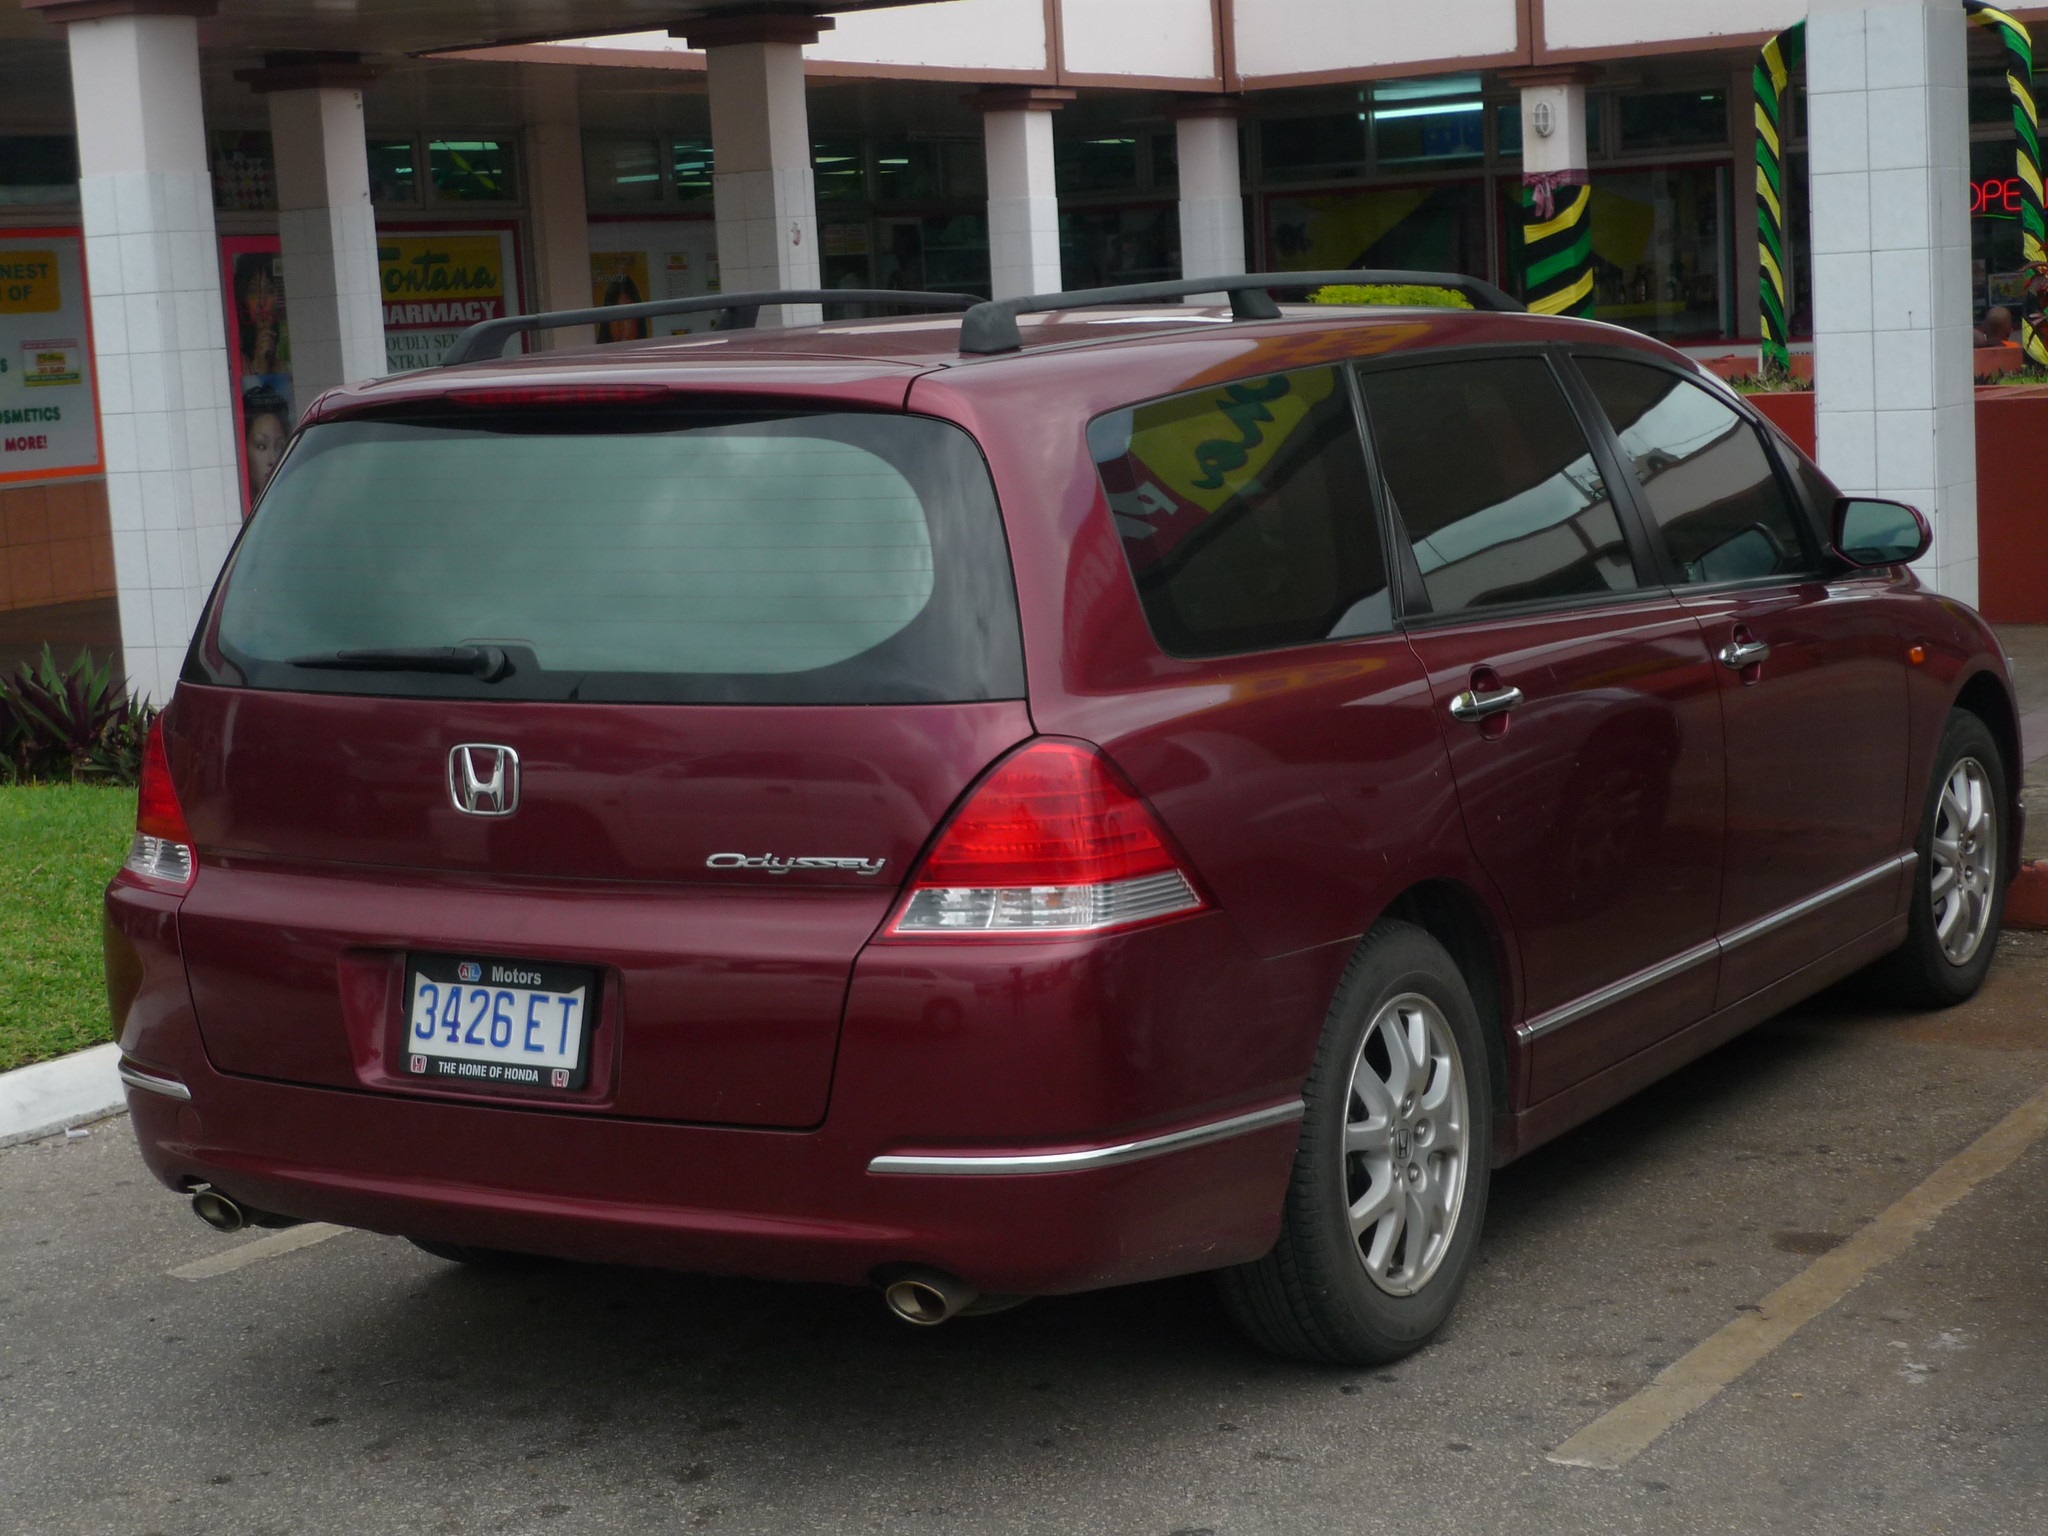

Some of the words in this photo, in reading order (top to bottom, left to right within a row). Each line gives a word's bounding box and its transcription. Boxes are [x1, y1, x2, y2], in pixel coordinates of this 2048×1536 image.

[378, 248, 496, 293] ontana
[0, 407, 61, 424] SMETICS
[5, 435, 47, 451] MORE!
[706, 852, 886, 875] Odyssey
[492, 966, 542, 985] Motors
[415, 983, 515, 1048] 3426
[524, 994, 579, 1055] ET
[438, 1061, 457, 1075] THE
[458, 1063, 487, 1077] HOME
[489, 1065, 502, 1078] OF
[504, 1066, 539, 1082] HONDA
